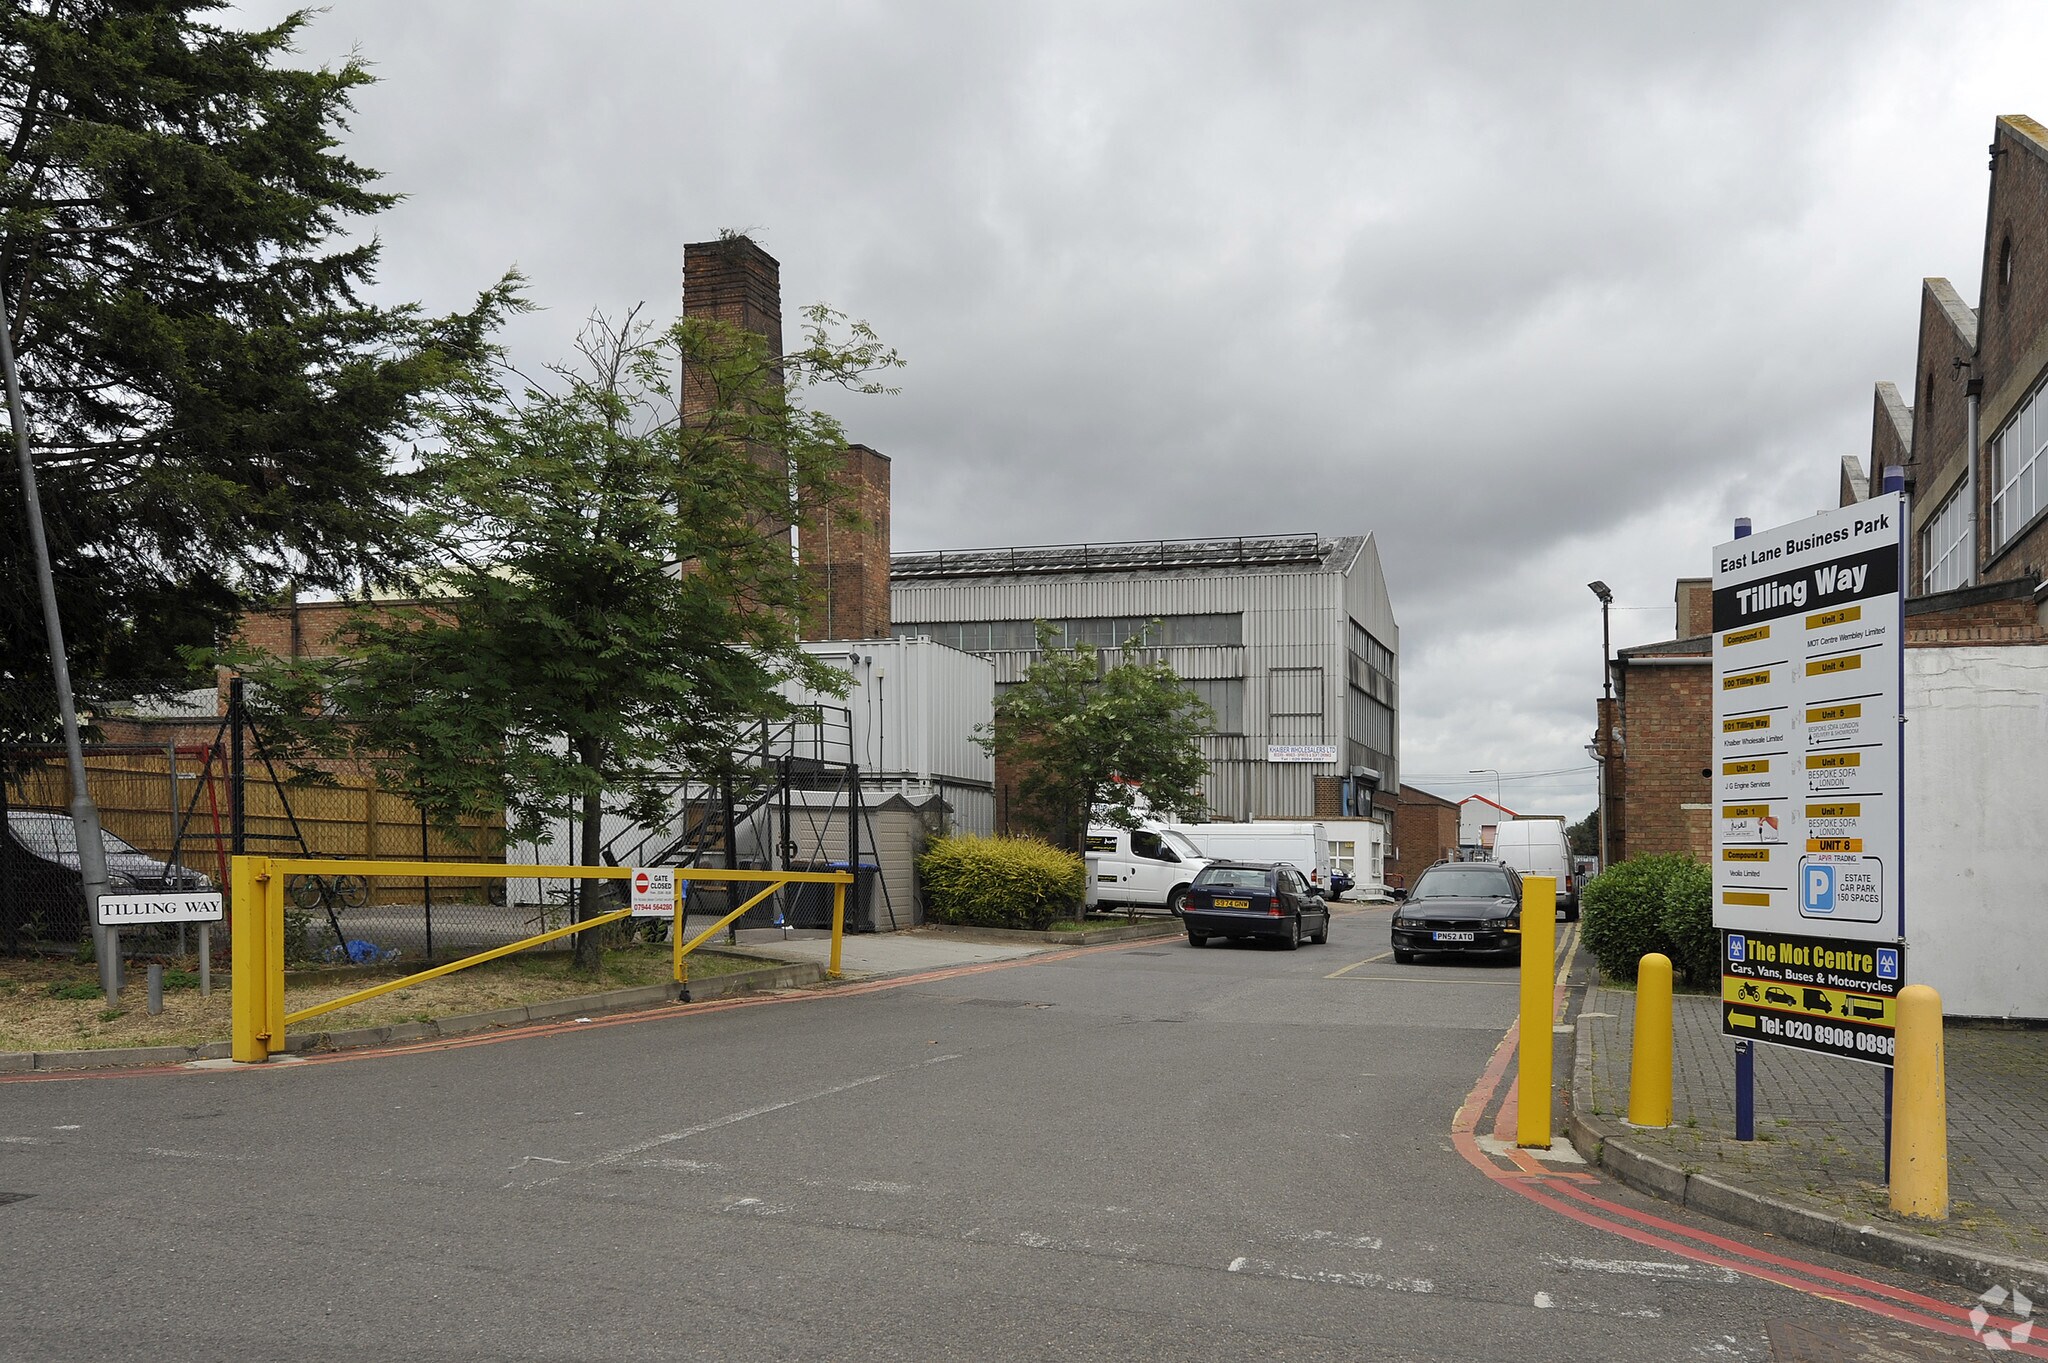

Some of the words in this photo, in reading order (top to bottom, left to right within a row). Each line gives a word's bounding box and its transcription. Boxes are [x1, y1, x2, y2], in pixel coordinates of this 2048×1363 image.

[1721, 558, 1747, 573] East
[1752, 547, 1781, 564] Lane
[1786, 528, 1849, 555] Business
[1854, 514, 1890, 536] Park
[1736, 579, 1807, 615] Tilling
[1814, 563, 1868, 596] Way
[1822, 615, 1836, 624] Unit
[1727, 632, 1758, 644] Compound
[1807, 639, 1819, 647] MOT
[1820, 636, 1838, 645] Centre
[1839, 631, 1863, 641] Wembley
[1864, 626, 1886, 637] Limited
[1822, 663, 1836, 671] Unit
[1736, 677, 1754, 686] Tilling
[1755, 675, 1767, 683] Way
[1822, 711, 1836, 719] Unit
[1736, 721, 1754, 730] Tilling
[1755, 720, 1768, 728] Way
[1766, 734, 1783, 742] Limited
[1822, 758, 1836, 766] Unit
[1840, 757, 1844, 765] 6
[1808, 769, 1837, 779] BESPOKE
[1839, 768, 1856, 778] SOFA
[1734, 782, 1749, 790] Engine
[1820, 779, 1844, 787] LONDON
[1736, 808, 1748, 816] Unit
[1839, 807, 1844, 815] 7
[1808, 819, 1837, 828] BESPOKE
[1839, 818, 1856, 827] SOFA
[1820, 828, 1844, 836] LONDON
[1820, 840, 1841, 850] UNIT
[1844, 840, 1850, 850] 8
[1728, 851, 1758, 860] Compound
[1845, 874, 1871, 882] ESTATE
[1840, 883, 1854, 892] CAR
[1856, 884, 1876, 893] PARK
[1837, 893, 1849, 901] 150
[1850, 894, 1879, 903] SPACES
[101, 902, 177, 915] TILLING
[185, 901, 221, 912] WAY
[1747, 939, 1776, 962] The
[1779, 942, 1810, 967] Mot
[1813, 946, 1873, 973] Centre
[1731, 963, 1755, 976] Cars,
[1757, 965, 1783, 980] Vans,
[1785, 971, 1814, 982] Buses
[1816, 973, 1825, 984] &
[1828, 975, 1894, 993] Motorcycles
[1760, 1015, 1784, 1036] Tel:
[1785, 1020, 1813, 1041] 020
[1814, 1024, 1854, 1049] 8908
